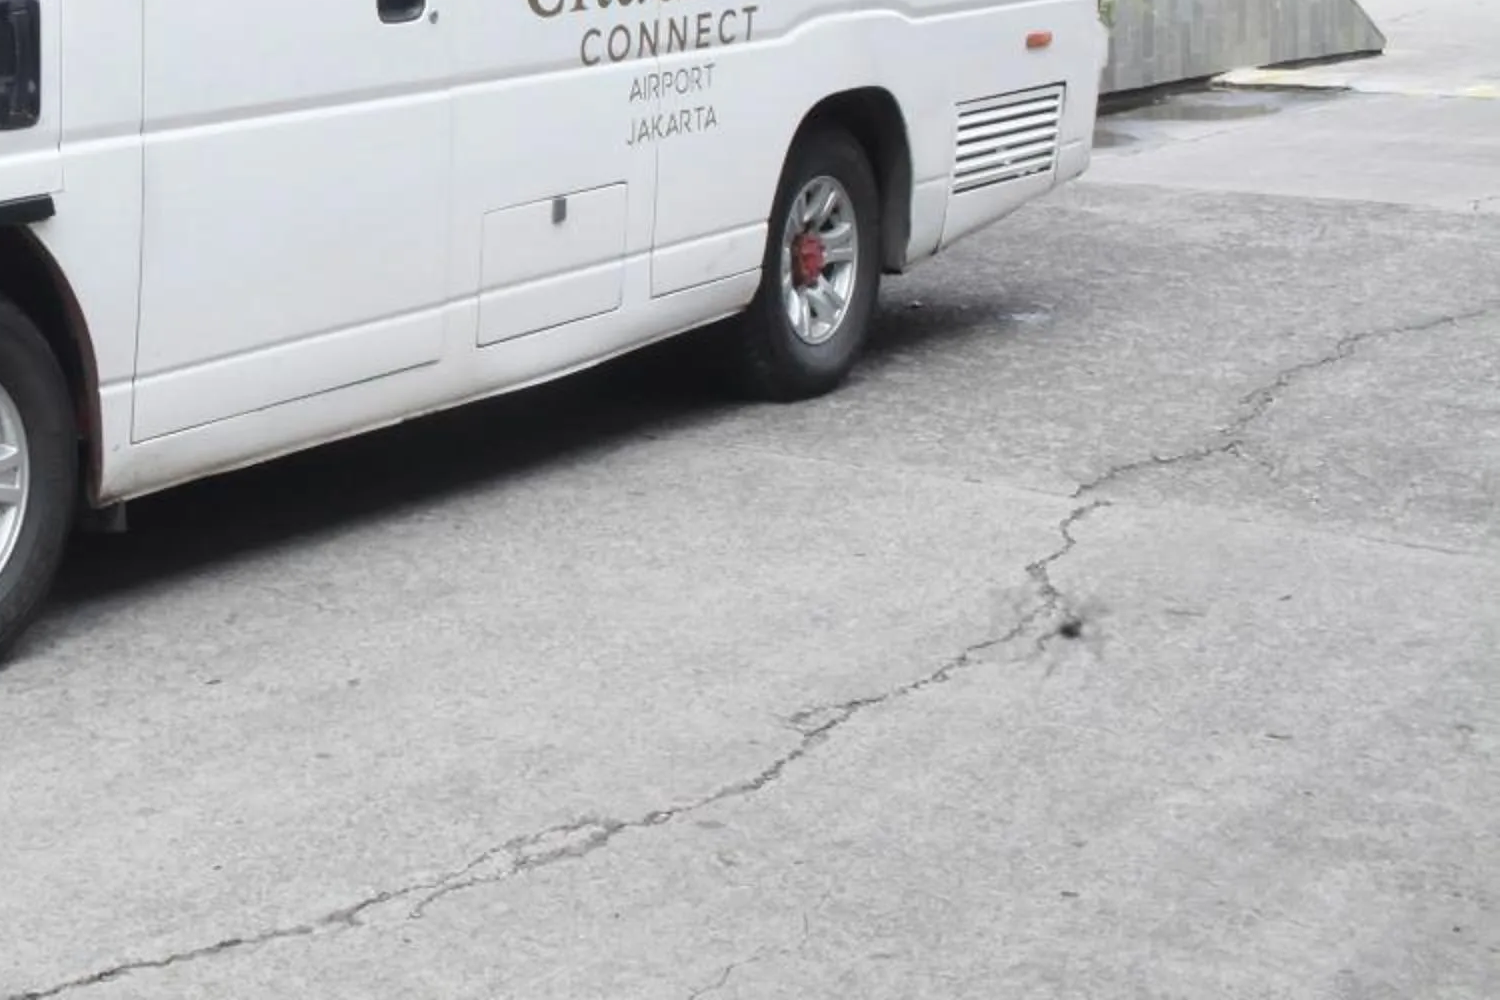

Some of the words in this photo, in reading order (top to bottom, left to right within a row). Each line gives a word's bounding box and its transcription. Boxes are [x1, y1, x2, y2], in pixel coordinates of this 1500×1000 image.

[580, 5, 758, 66] CONNECT
[629, 63, 715, 102] AIRPORT
[627, 106, 717, 146] JAKARTA
